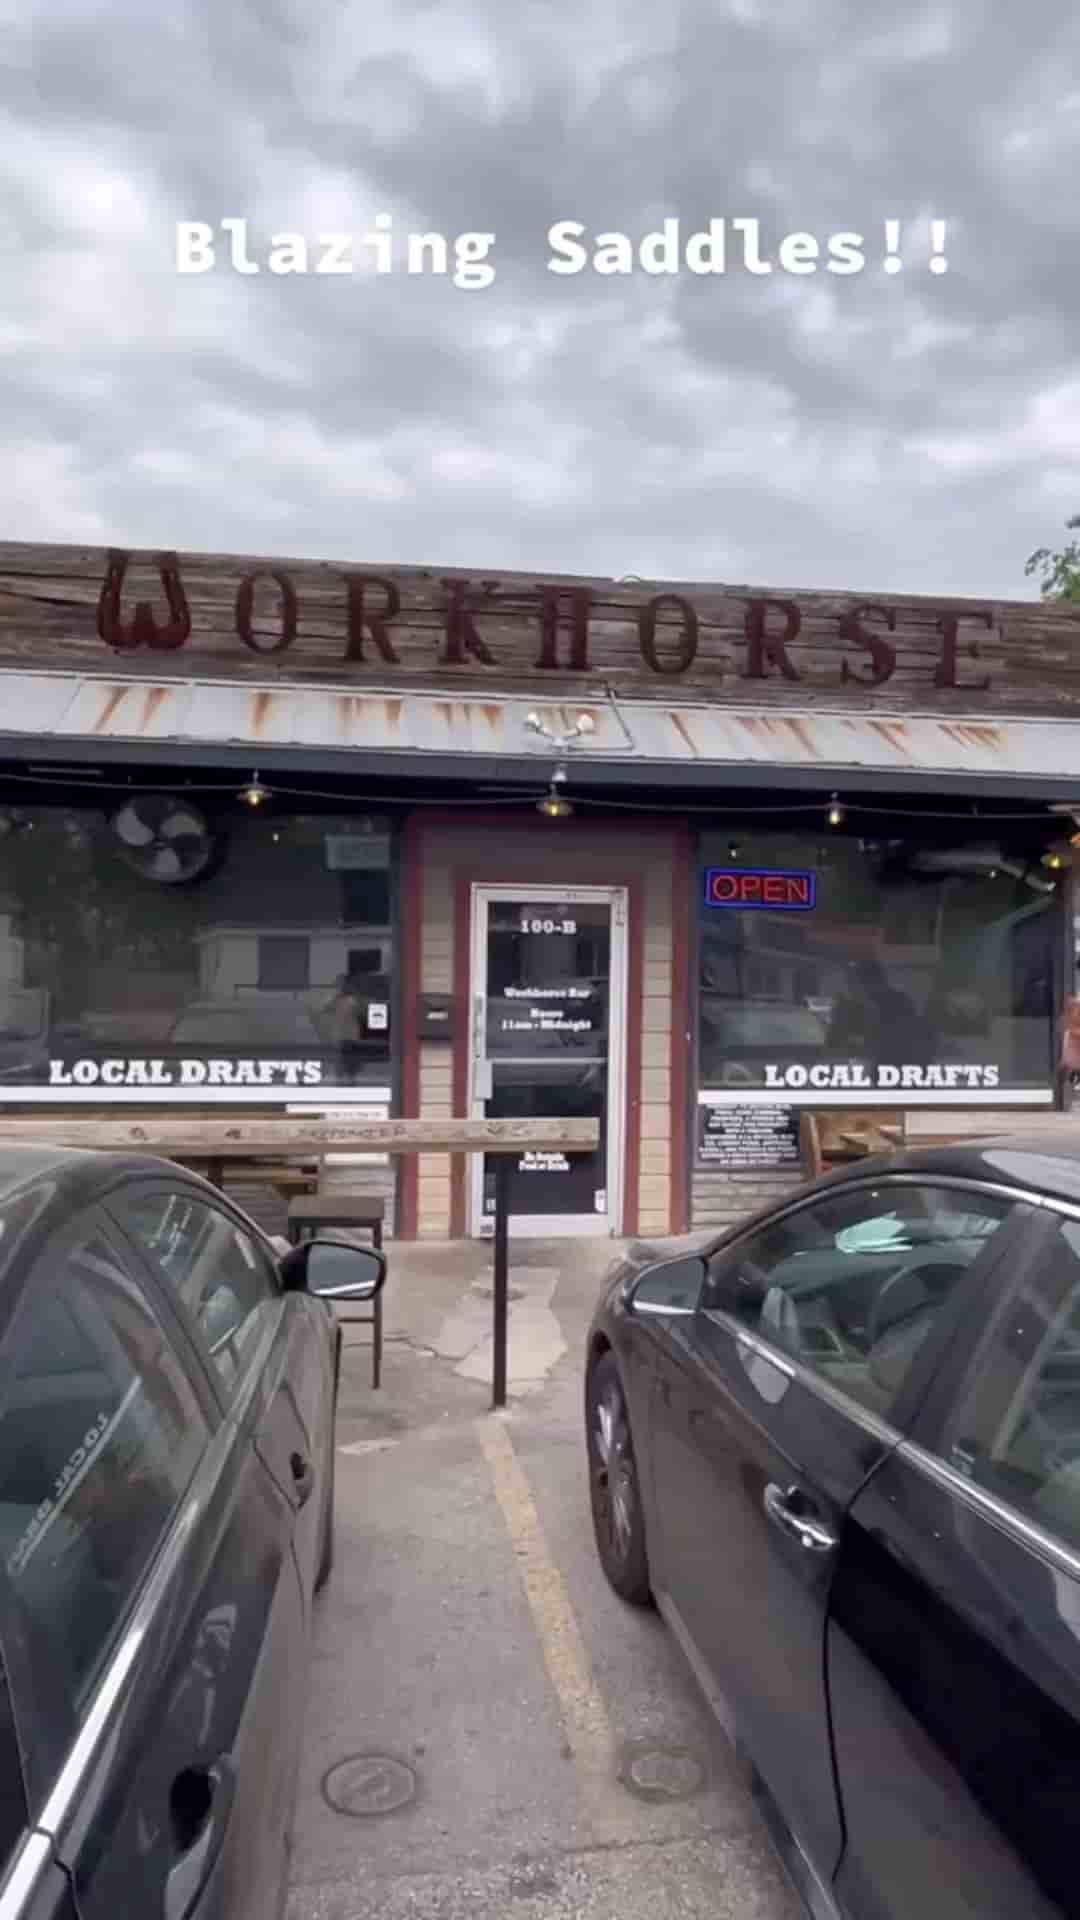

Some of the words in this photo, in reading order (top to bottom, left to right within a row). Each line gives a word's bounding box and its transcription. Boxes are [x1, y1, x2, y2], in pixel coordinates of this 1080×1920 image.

[97, 548, 998, 690] WORKHORSE
[713, 874, 809, 903] OPEN
[520, 919, 577, 934] 100-B
[49, 1059, 172, 1085] LOCAL
[179, 1059, 322, 1085] DRAFTS
[765, 1064, 872, 1088] LOCAL
[877, 1064, 1000, 1088] DRAFTS
